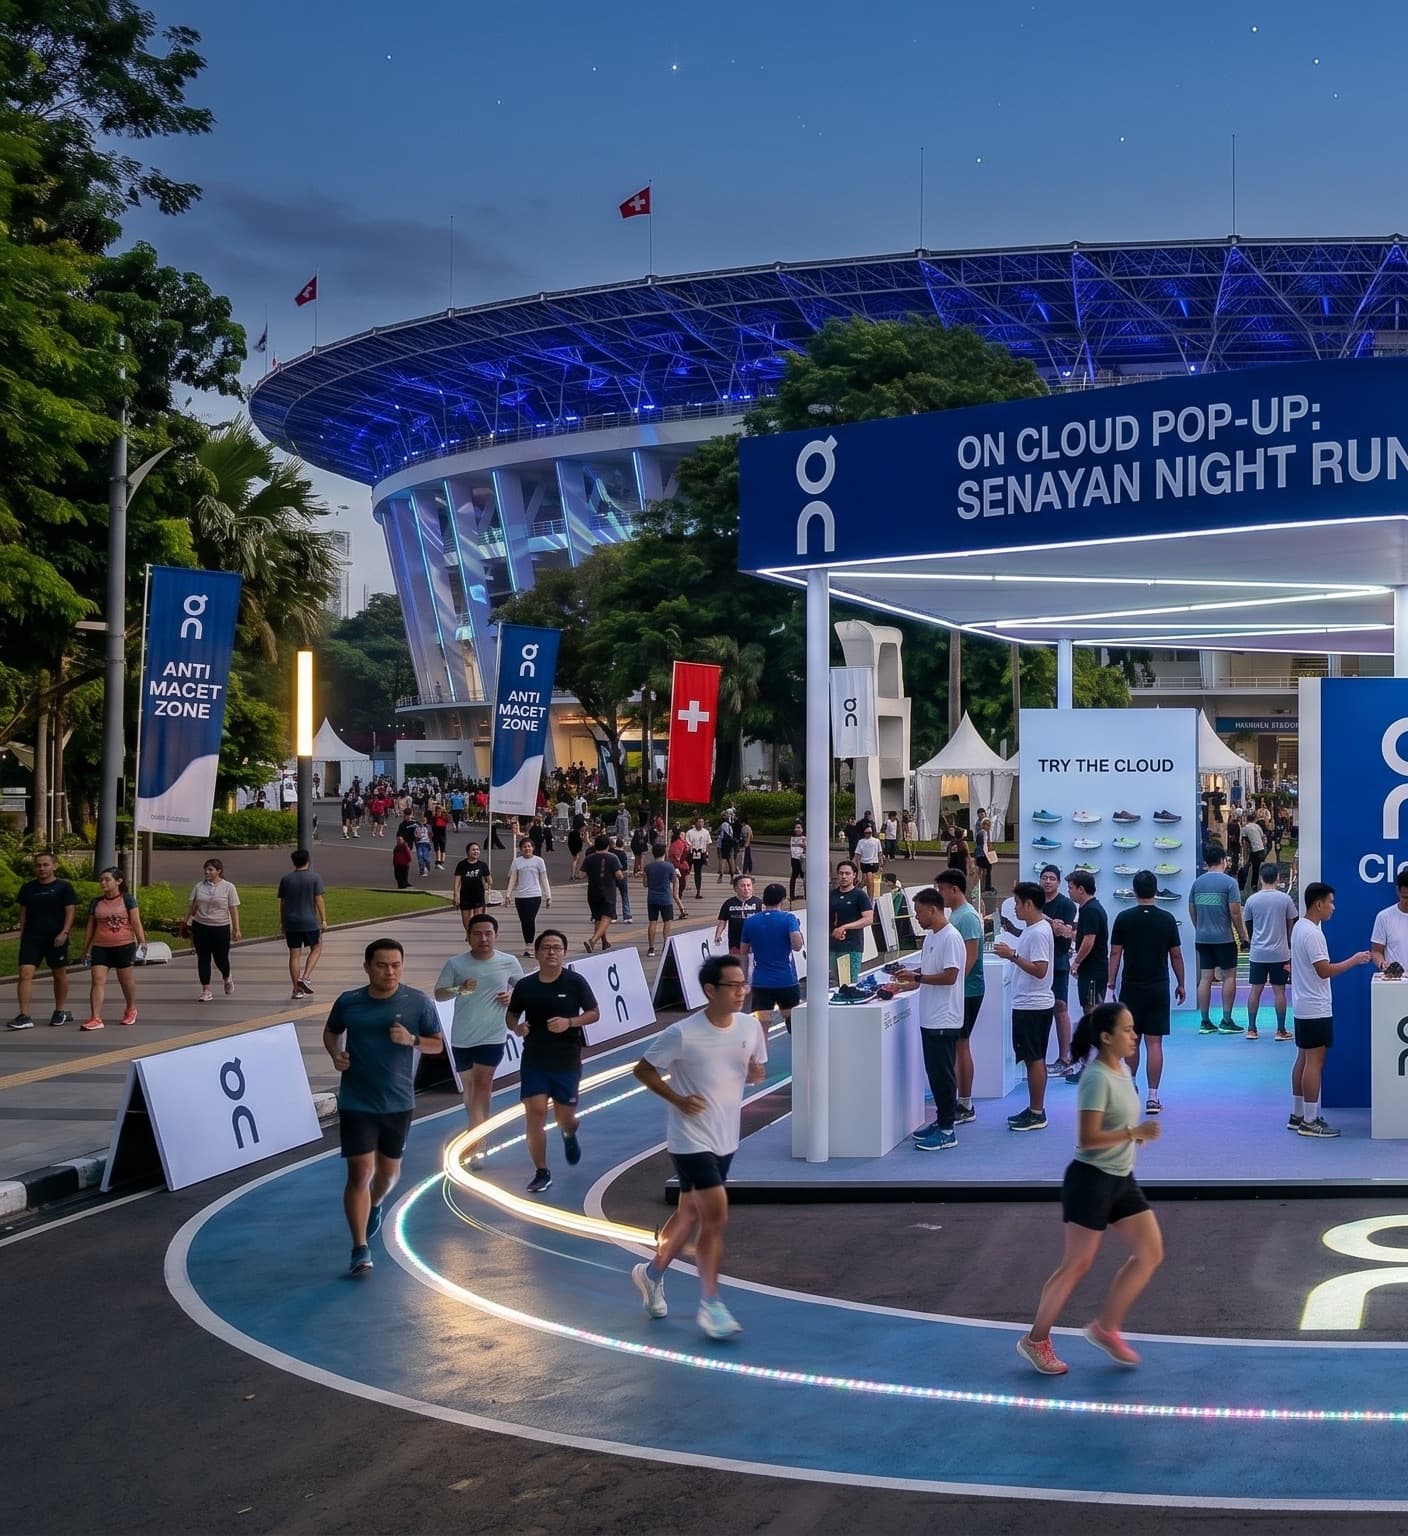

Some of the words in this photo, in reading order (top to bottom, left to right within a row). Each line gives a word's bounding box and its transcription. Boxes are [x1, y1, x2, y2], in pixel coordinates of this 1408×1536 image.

[957, 431, 1005, 470] ON
[1016, 415, 1140, 463] CLOUD
[1152, 394, 1321, 447] POP-UP:
[957, 461, 1140, 520] SENAYAN
[1155, 444, 1297, 500] NIGHT
[162, 661, 211, 680] ANTI
[149, 680, 223, 700] MACET
[507, 690, 540, 704] ANTI
[154, 700, 211, 719] ZONE
[498, 703, 547, 718] MACET
[501, 718, 539, 732] ZONE
[1037, 758, 1071, 773] TRY
[1075, 758, 1110, 773] THE
[1114, 758, 1174, 773] CLOUD
